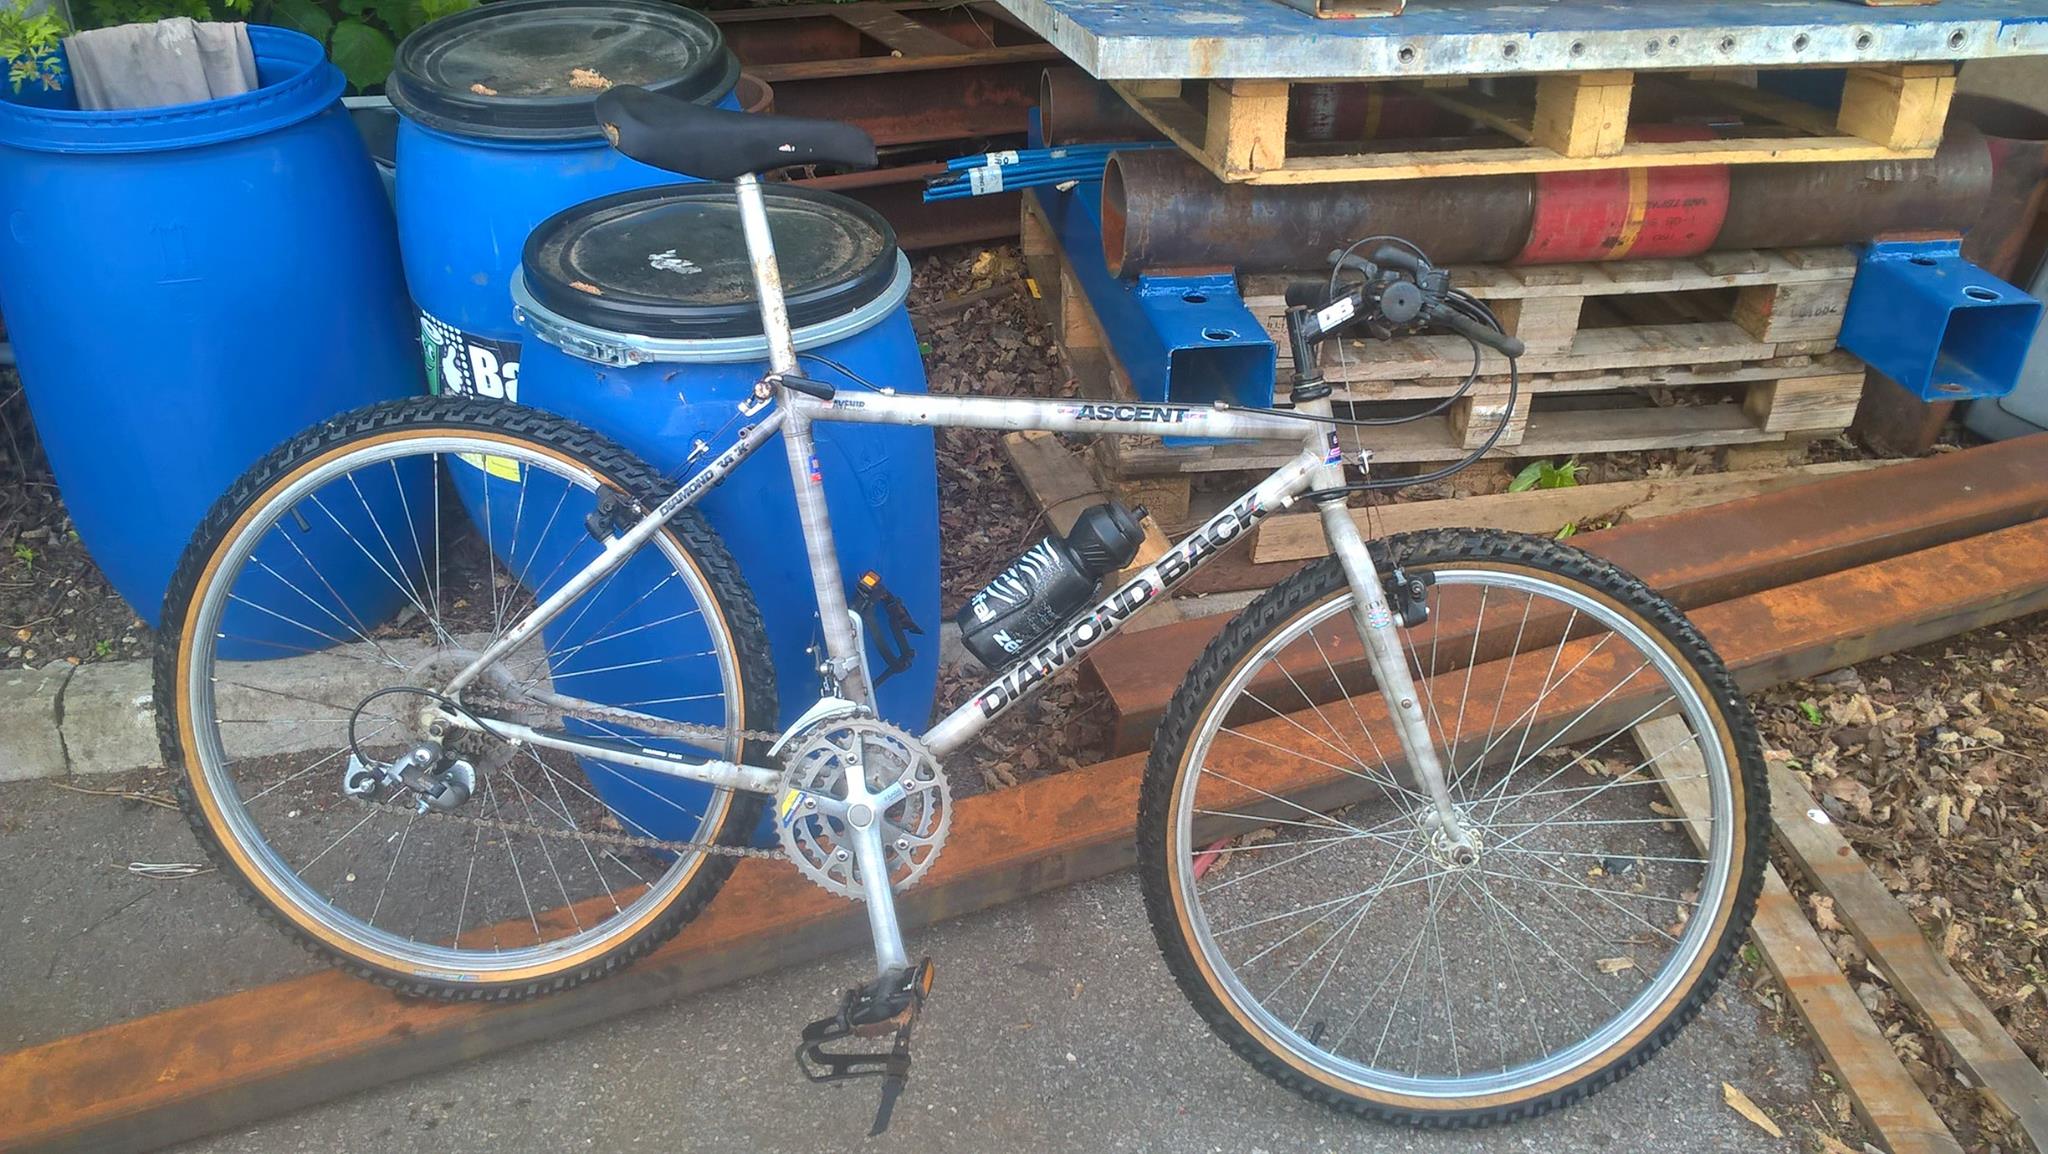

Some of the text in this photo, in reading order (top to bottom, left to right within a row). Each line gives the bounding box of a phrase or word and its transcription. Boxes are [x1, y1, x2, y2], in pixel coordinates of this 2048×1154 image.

[1075, 404, 1190, 423] ASCENT
[660, 470, 714, 516] DIAMOND
[978, 492, 1268, 719] DIAMOND BACK
